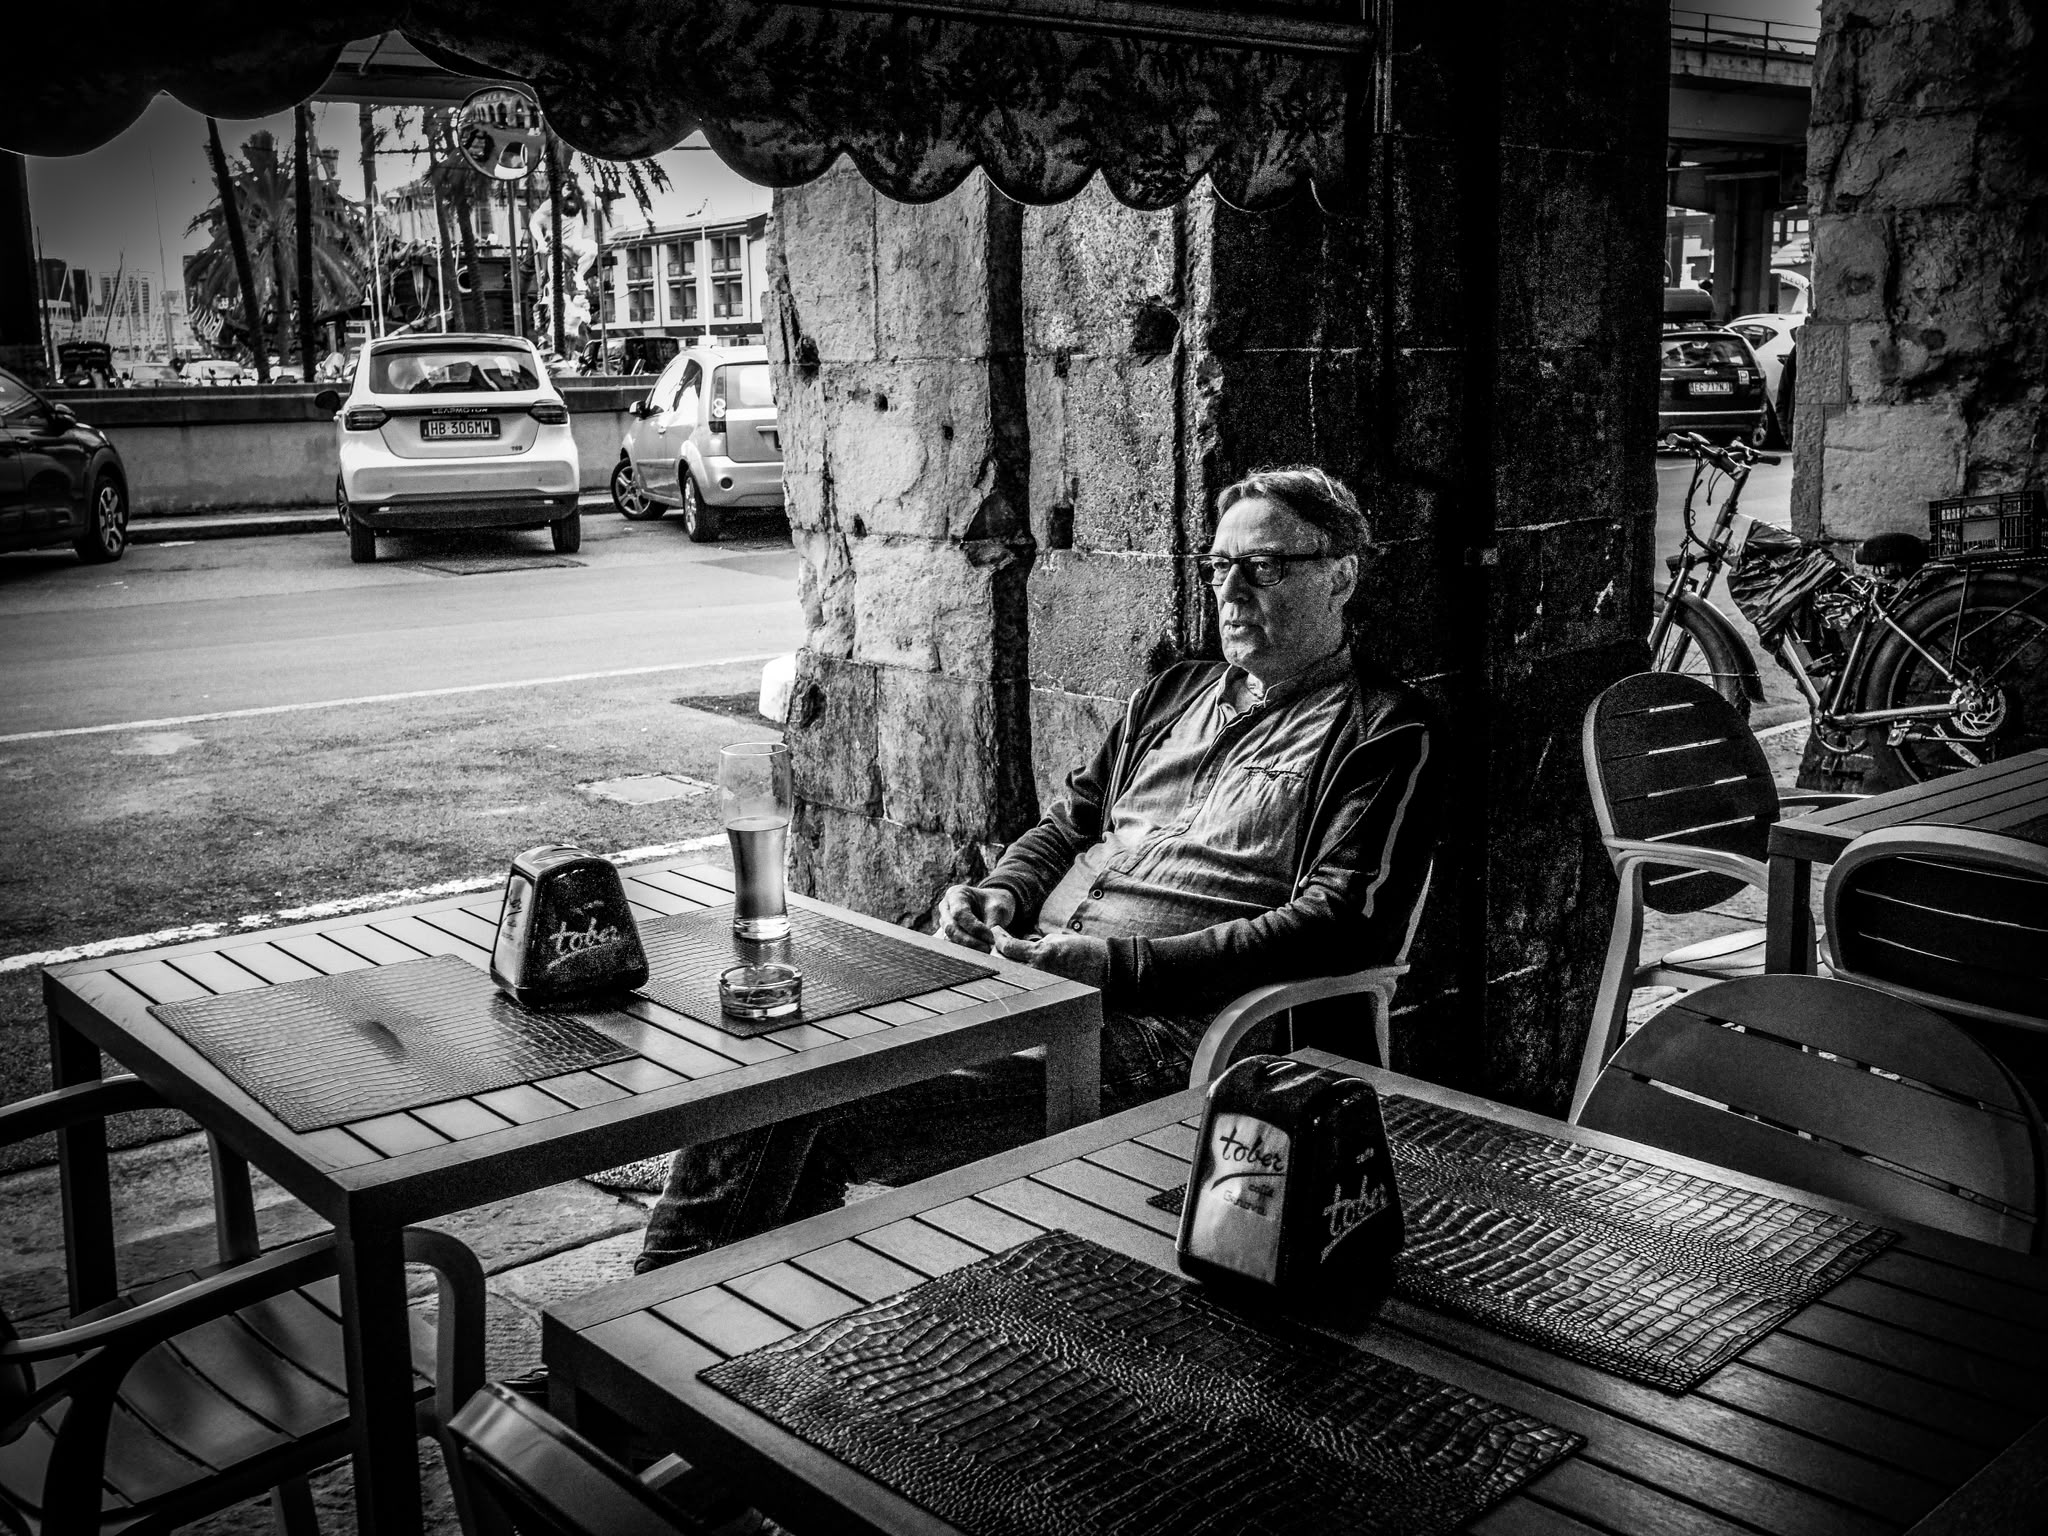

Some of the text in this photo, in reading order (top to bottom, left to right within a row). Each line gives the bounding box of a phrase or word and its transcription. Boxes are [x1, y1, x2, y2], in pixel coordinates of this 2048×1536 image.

[431, 420, 490, 435] HB 306MW
[1219, 1126, 1285, 1172] tober
